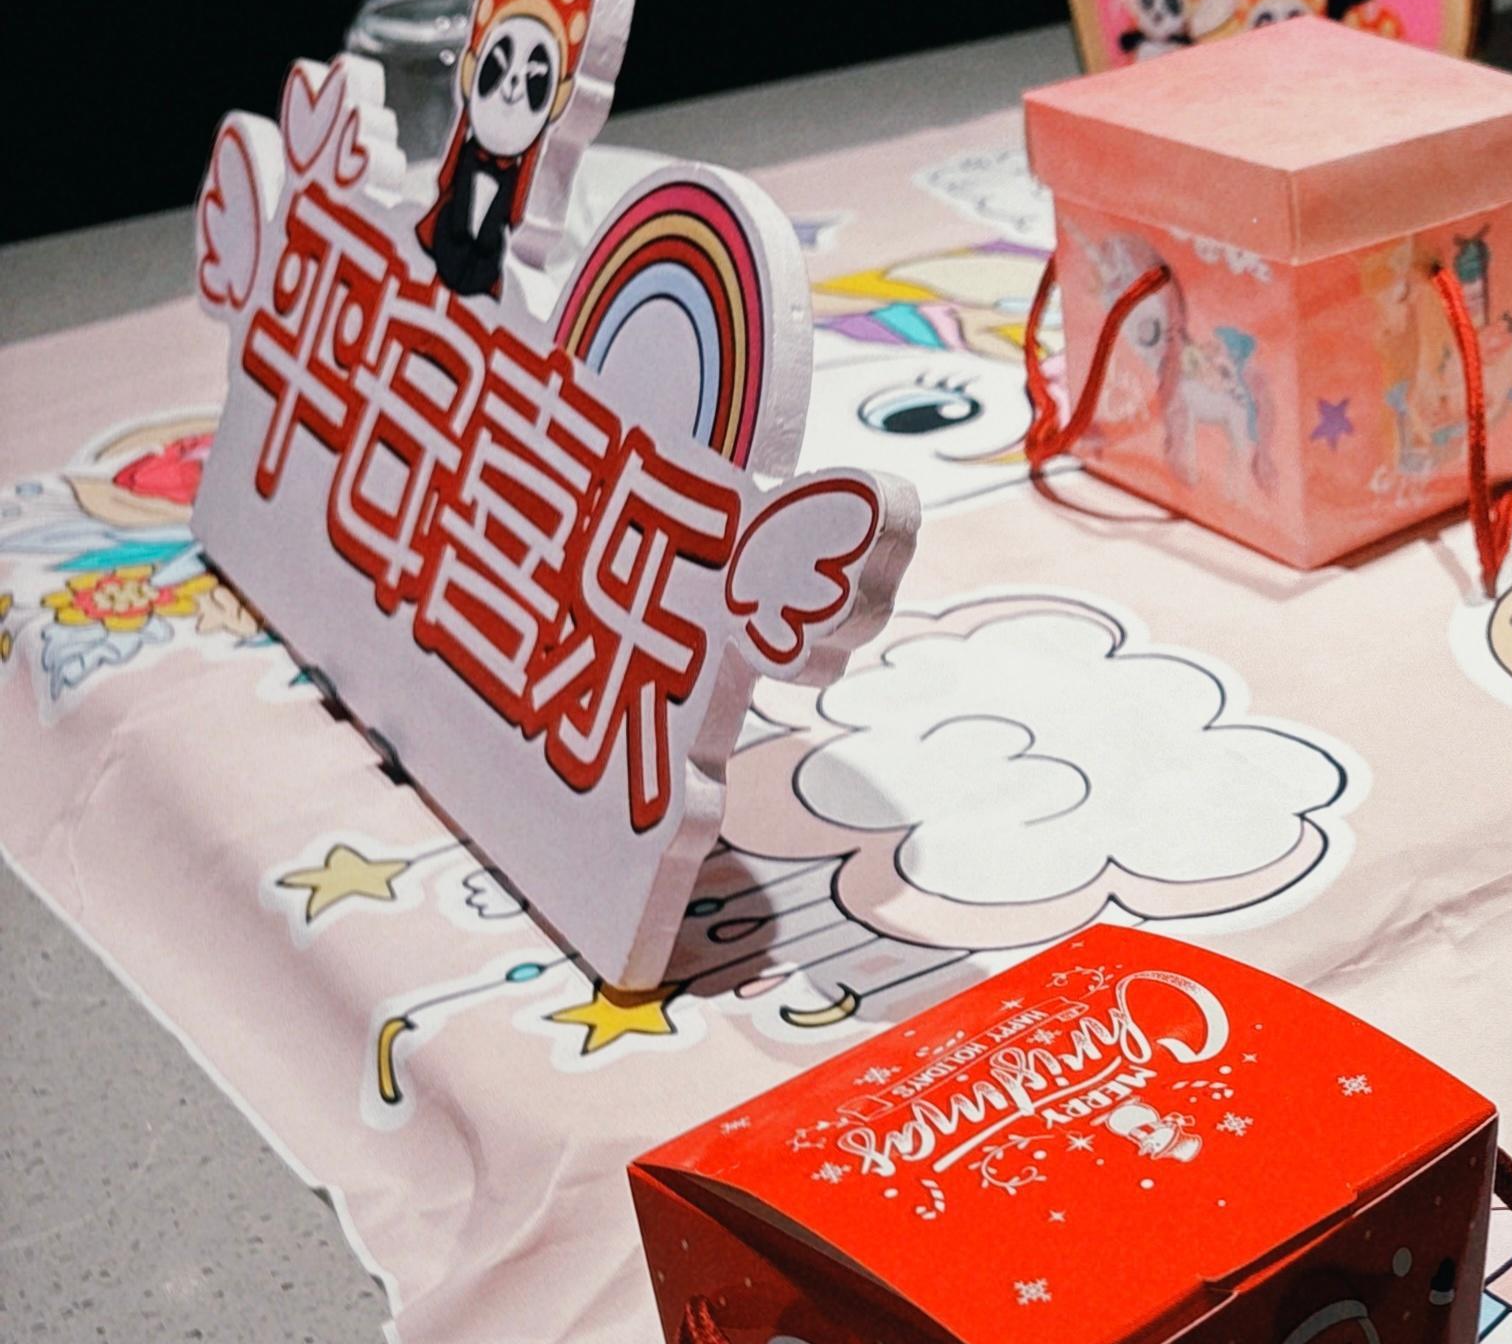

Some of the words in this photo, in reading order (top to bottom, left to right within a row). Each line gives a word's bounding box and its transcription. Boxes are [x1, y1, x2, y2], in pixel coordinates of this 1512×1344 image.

[994, 1009, 1050, 1045] HAPPY
[837, 970, 1229, 1177] Christmas
[891, 1042, 988, 1099] HOLIDAYS
[1041, 1065, 1157, 1129] MERRY
